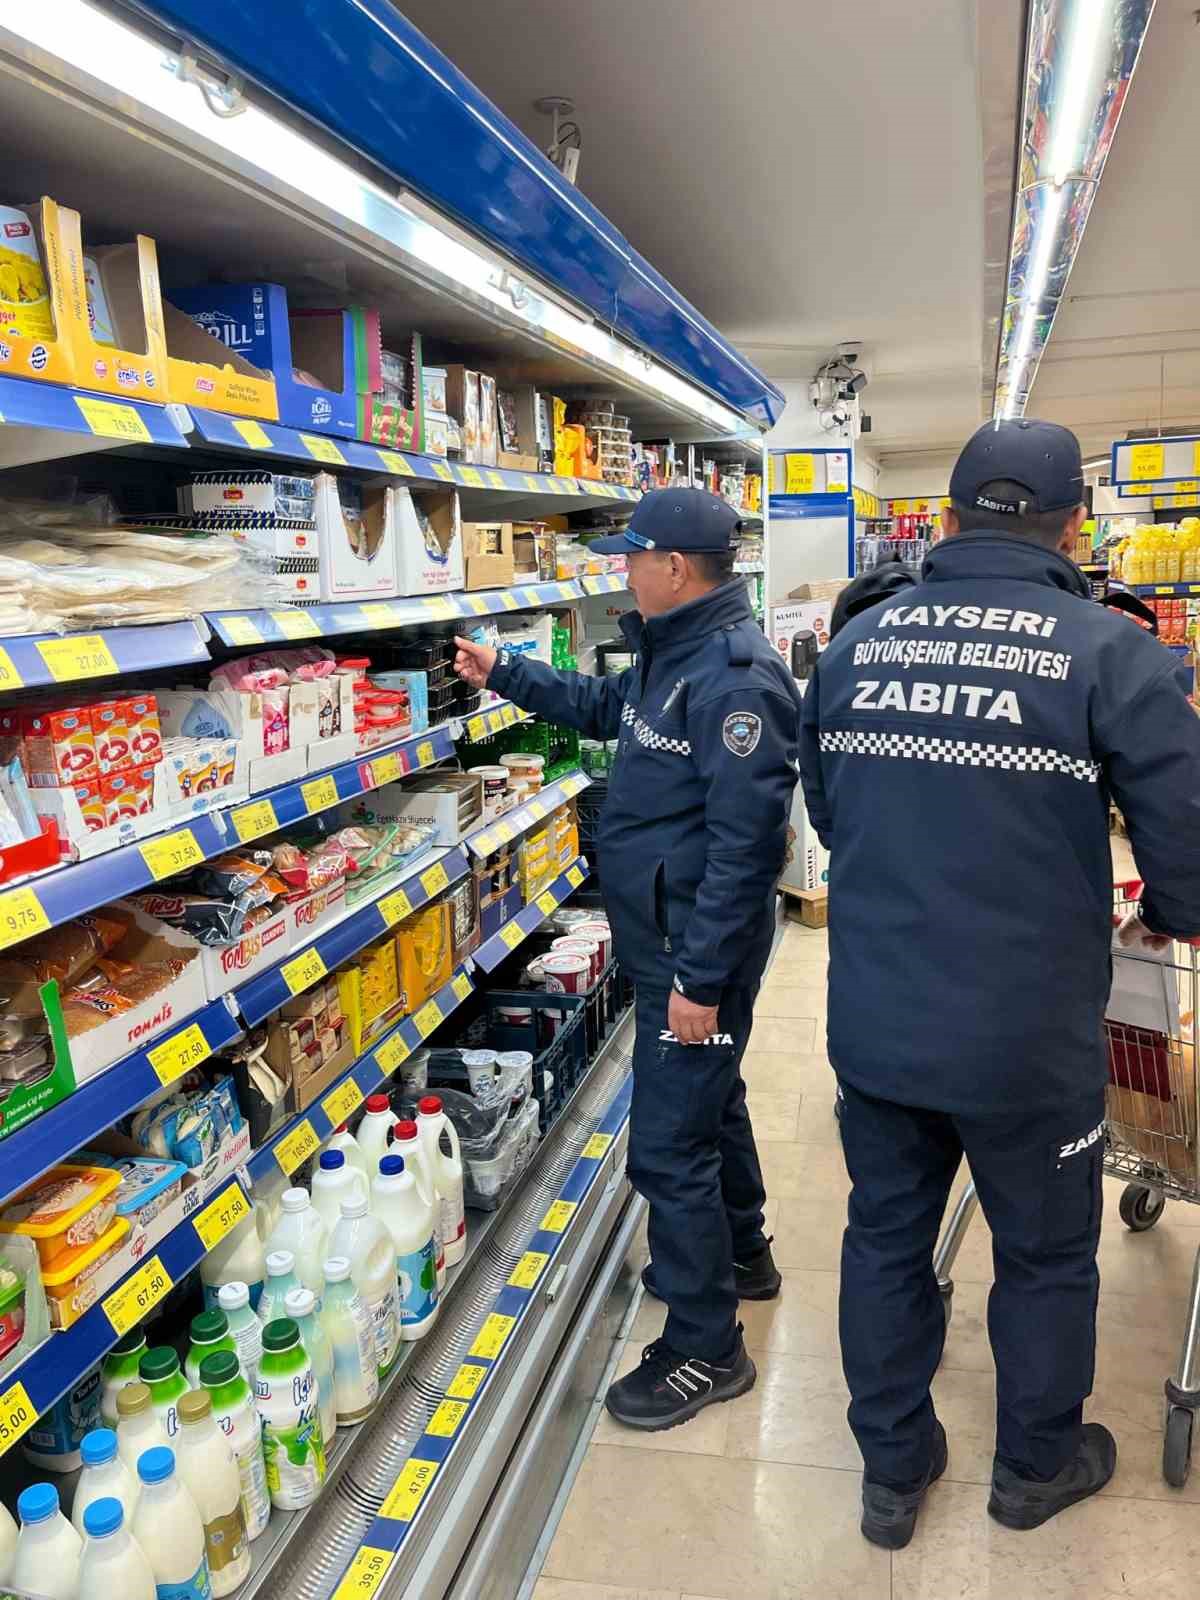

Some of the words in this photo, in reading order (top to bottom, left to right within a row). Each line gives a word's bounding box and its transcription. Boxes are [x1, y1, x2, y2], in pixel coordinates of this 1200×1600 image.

[976, 496, 1016, 512] ZABITA
[853, 635, 956, 669] BÜYÜKŞEHİR
[958, 641, 1072, 680] BELEDİYESİ
[851, 680, 1023, 725] ZABITA
